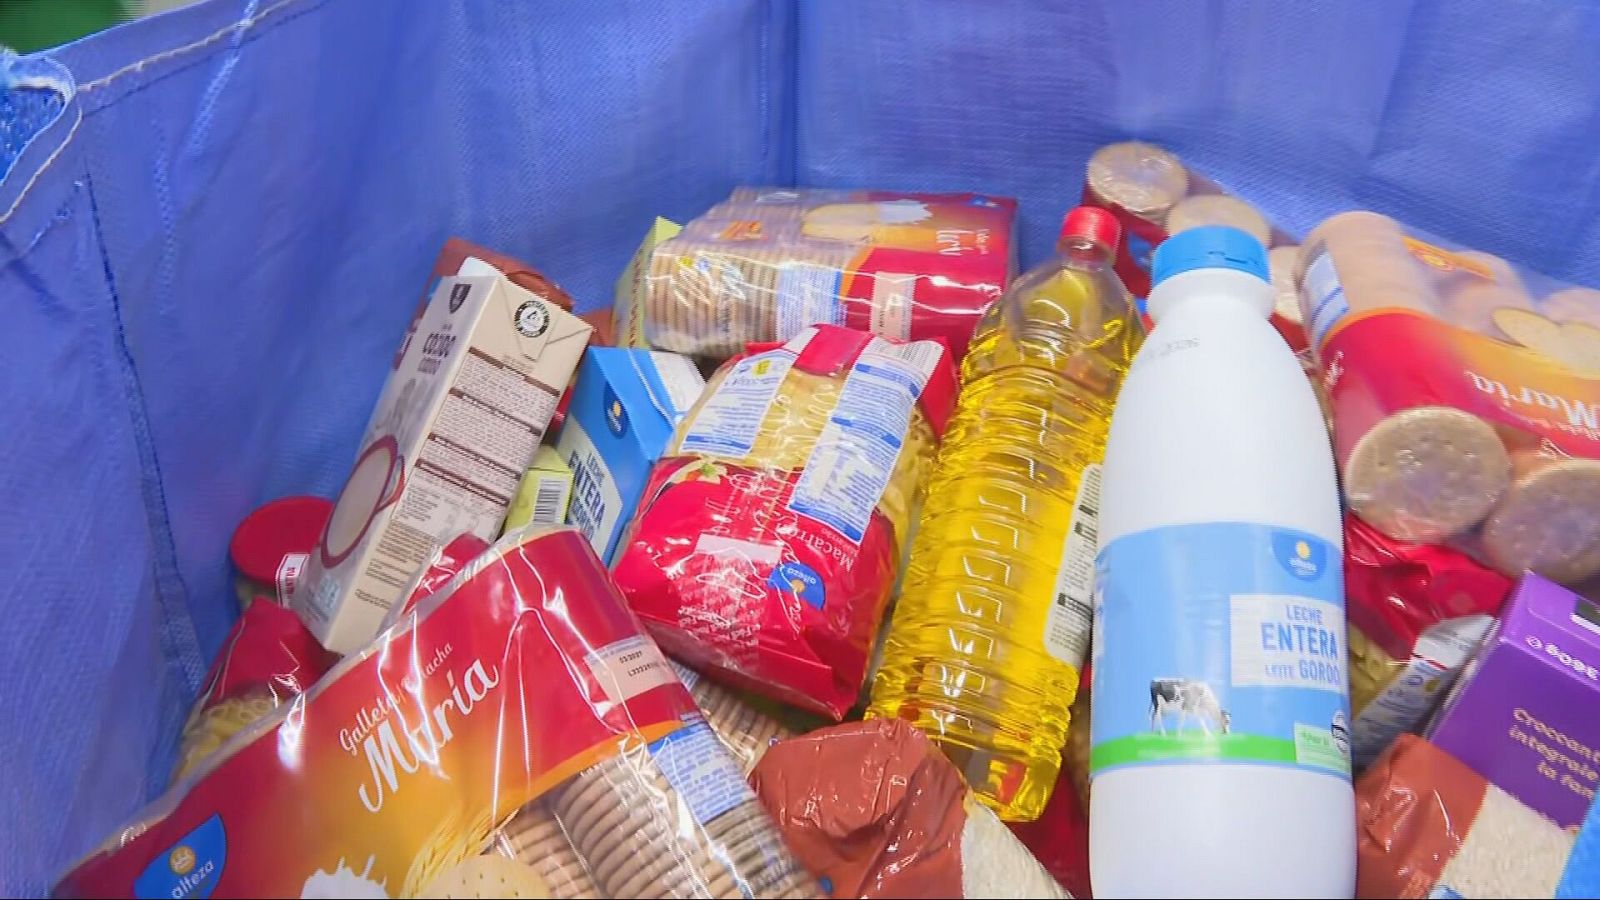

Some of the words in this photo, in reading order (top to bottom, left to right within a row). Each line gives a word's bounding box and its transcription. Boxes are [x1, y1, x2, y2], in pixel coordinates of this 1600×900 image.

[1286, 603, 1322, 625] LECHE
[1260, 622, 1338, 660] ENTERA
[1298, 659, 1341, 685] GORDO
[171, 860, 214, 900] alteza
